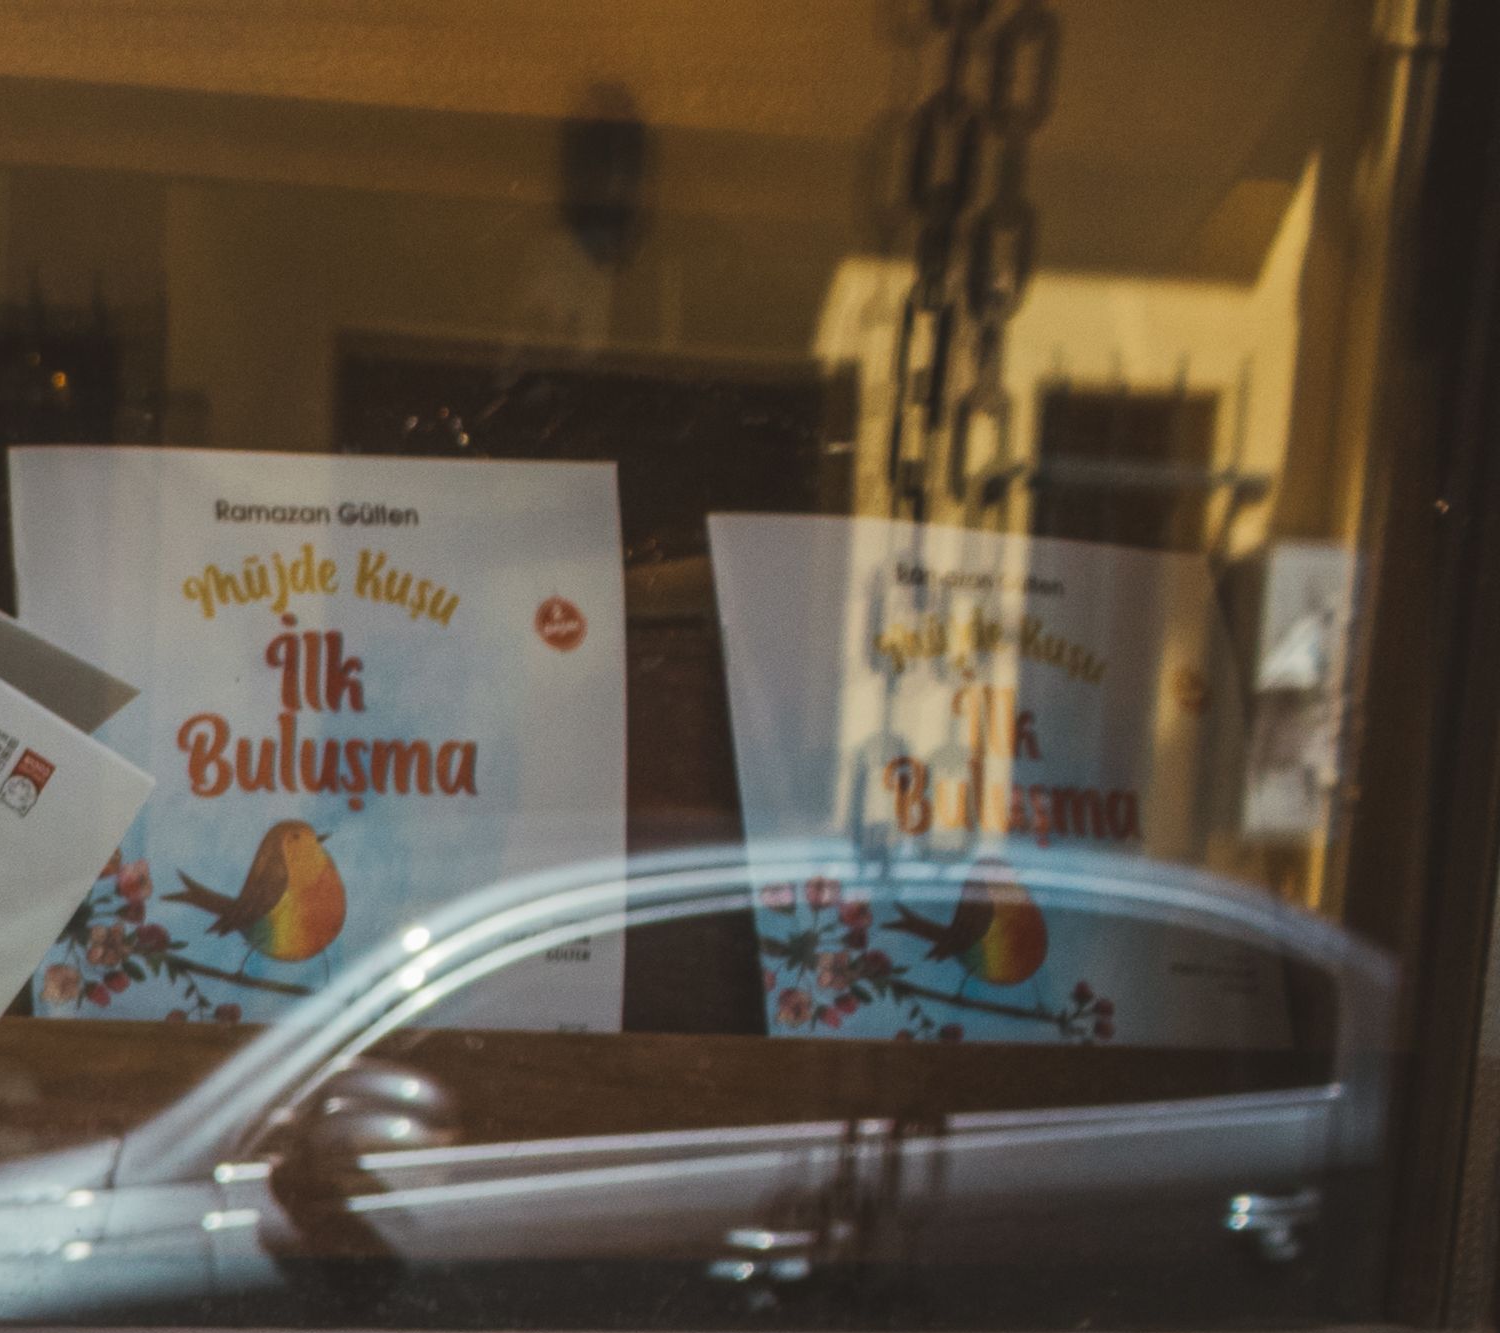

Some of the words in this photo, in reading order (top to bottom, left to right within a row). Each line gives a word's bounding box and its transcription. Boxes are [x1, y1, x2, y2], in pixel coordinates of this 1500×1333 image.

[215, 500, 330, 524] Ramazan
[338, 502, 419, 526] Gülten
[182, 543, 338, 620] Müjde
[354, 549, 460, 628] Kuşu
[265, 611, 365, 714] İlk
[177, 712, 478, 812] Buluşma
[882, 756, 1142, 848] Buluşma
